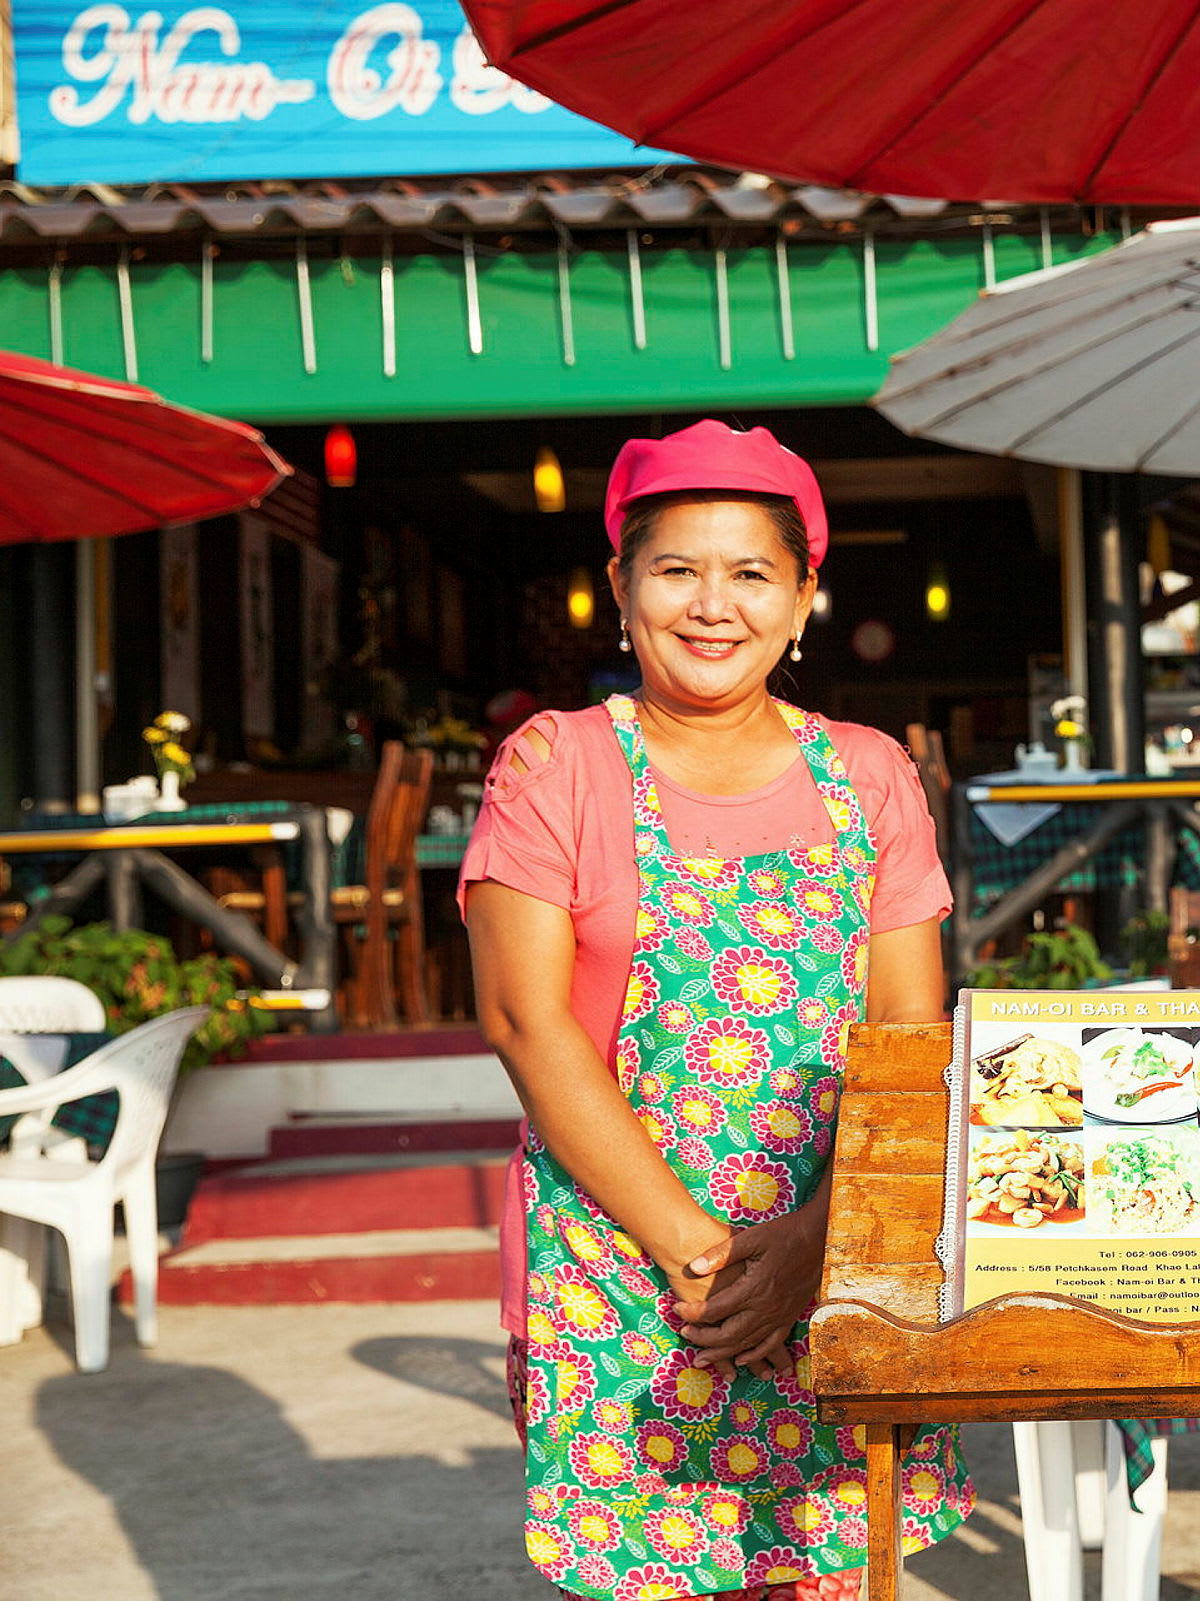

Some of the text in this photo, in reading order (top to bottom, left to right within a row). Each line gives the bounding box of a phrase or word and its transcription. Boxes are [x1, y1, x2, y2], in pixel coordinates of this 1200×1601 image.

[48, 3, 315, 127] Nam-
[327, 2, 444, 120] Oi
[991, 1002, 1073, 1016] NAM-OI
[1081, 1002, 1127, 1016] BAR
[1135, 1002, 1149, 1016] &
[1126, 1250, 1197, 1258] 062-906-0905
[975, 1264, 1017, 1272] Address
[1055, 1264, 1117, 1272] Petchkasem
[1056, 1278, 1106, 1286] Facebook
[1157, 1277, 1175, 1285] Bar
